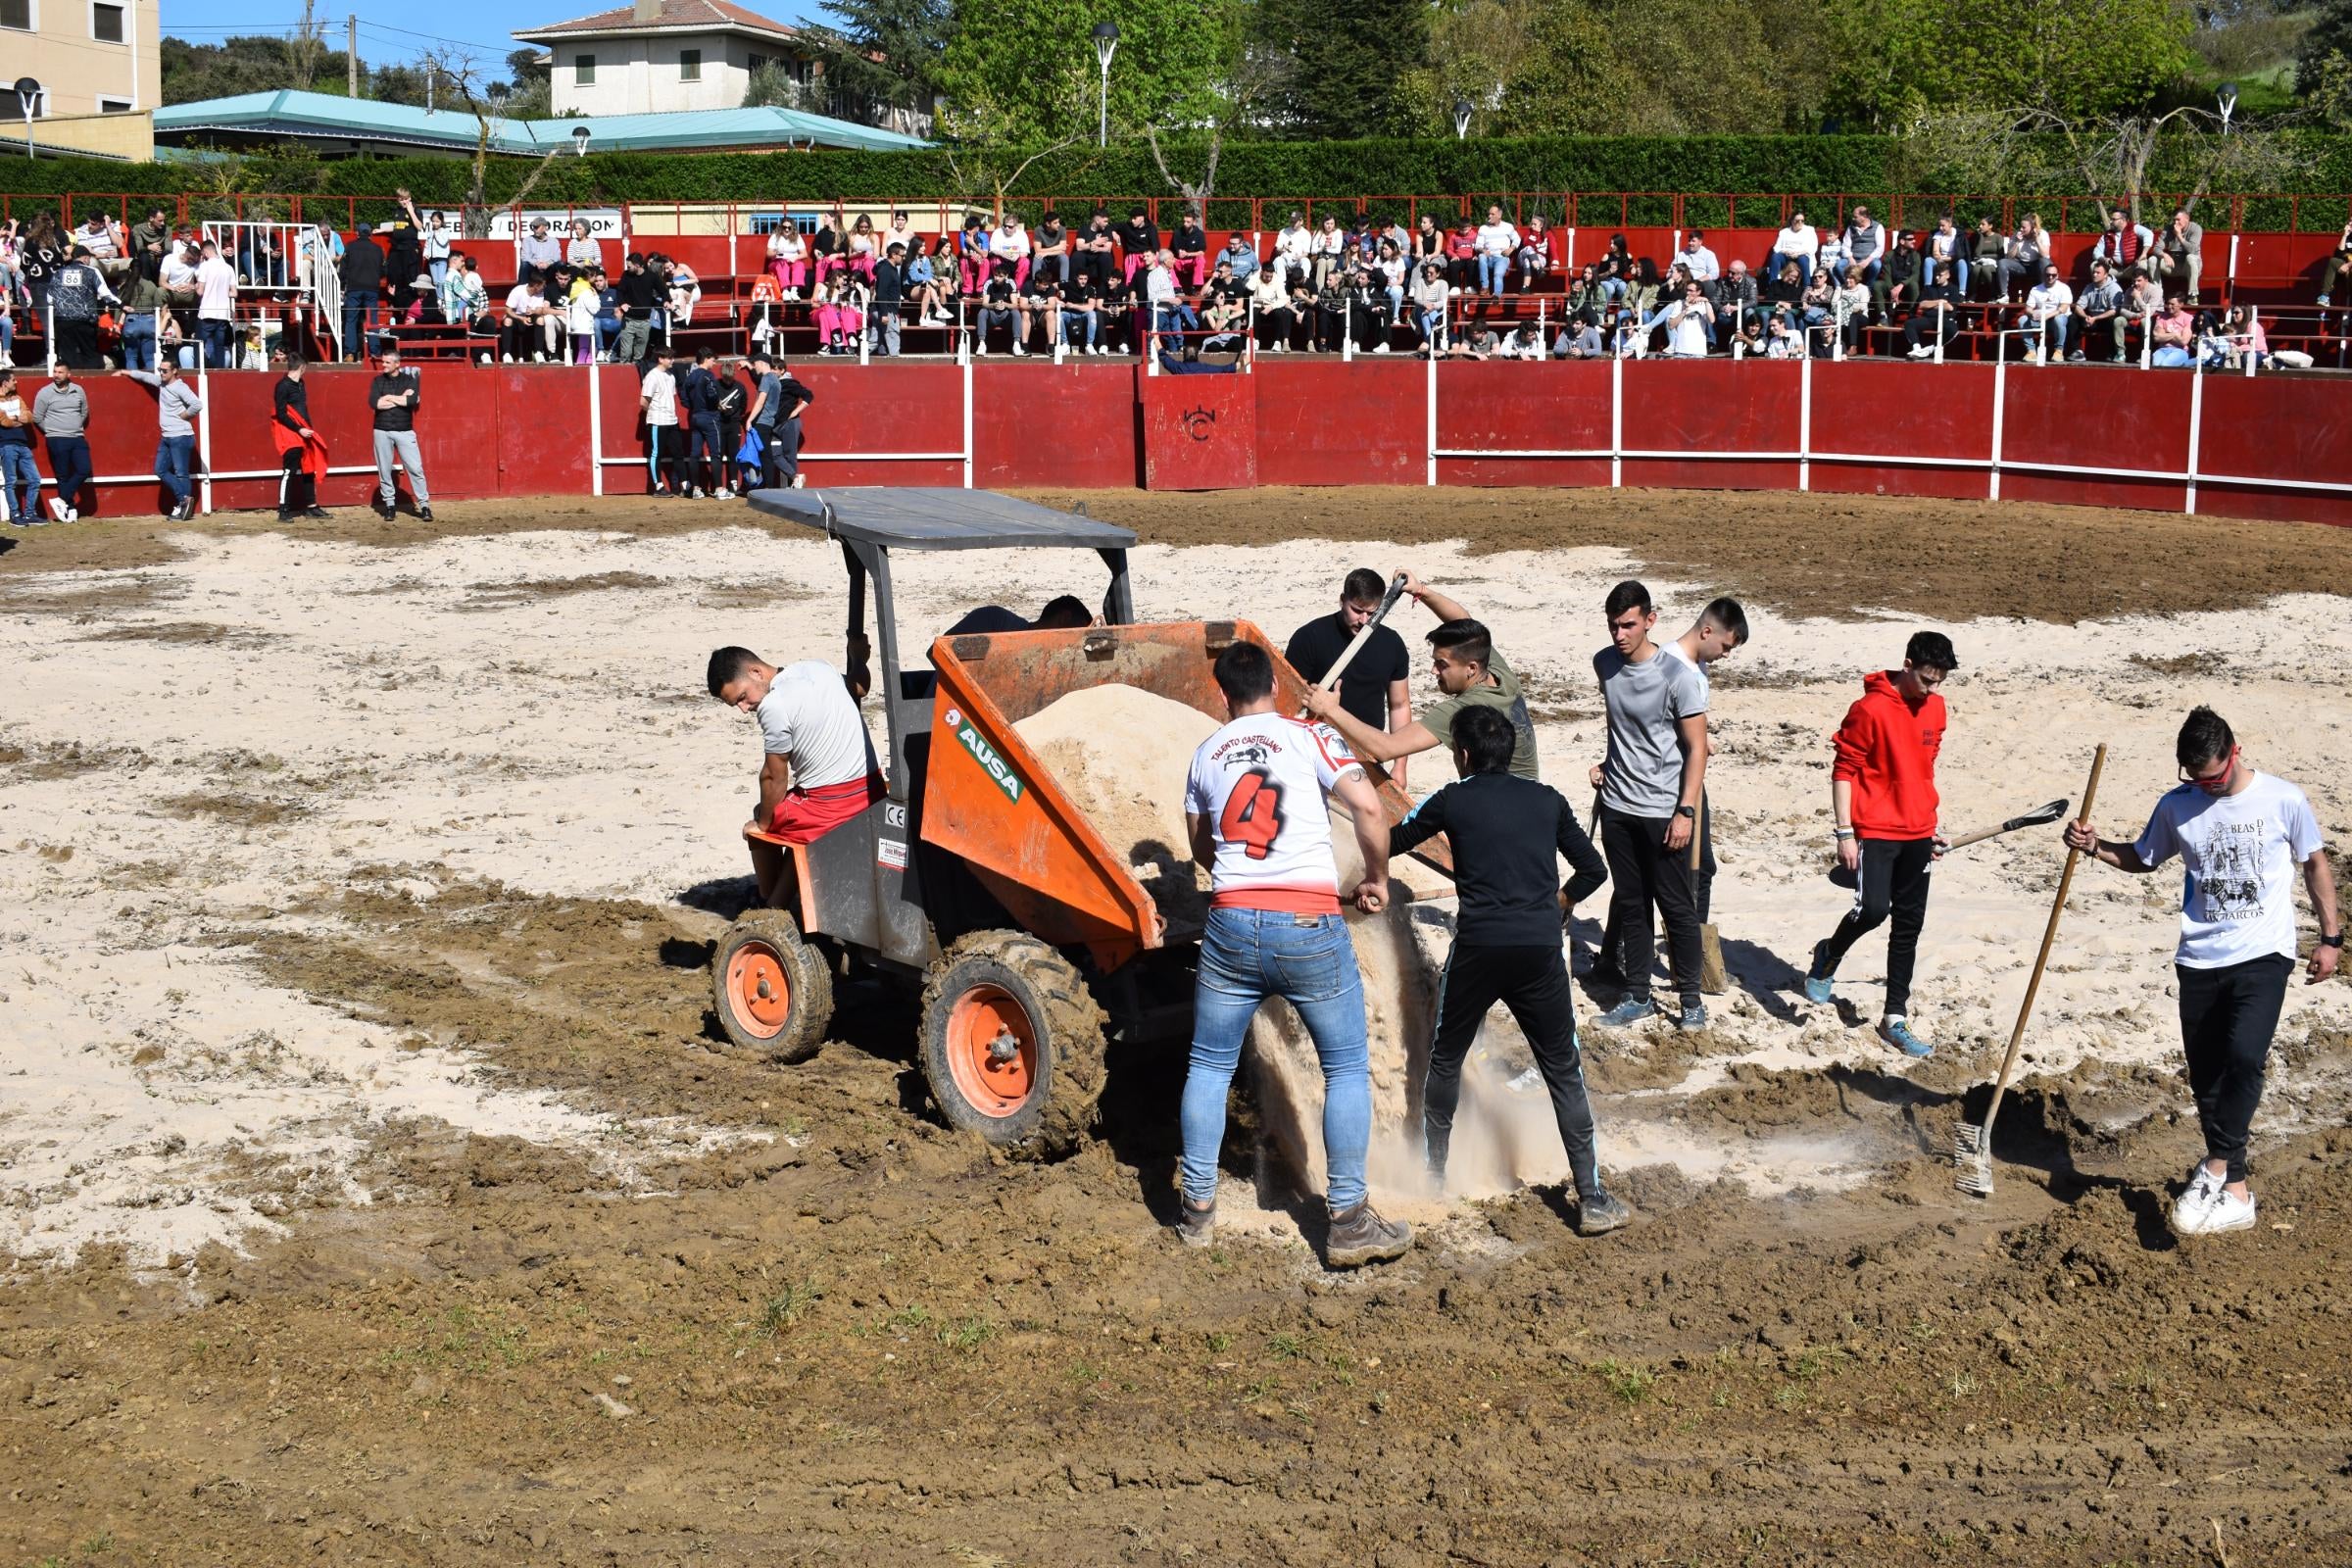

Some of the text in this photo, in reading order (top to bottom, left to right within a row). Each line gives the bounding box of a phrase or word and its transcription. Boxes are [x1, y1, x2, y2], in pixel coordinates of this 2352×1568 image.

[66, 274, 78, 284] 86
[1211, 735, 1282, 760] TALENTO CASTELLANO
[959, 728, 1018, 800] AUSA
[887, 807, 905, 826] CE
[1219, 771, 1280, 860] 4
[2230, 823, 2255, 834] BEAS
[2222, 910, 2265, 919] MARCOS
